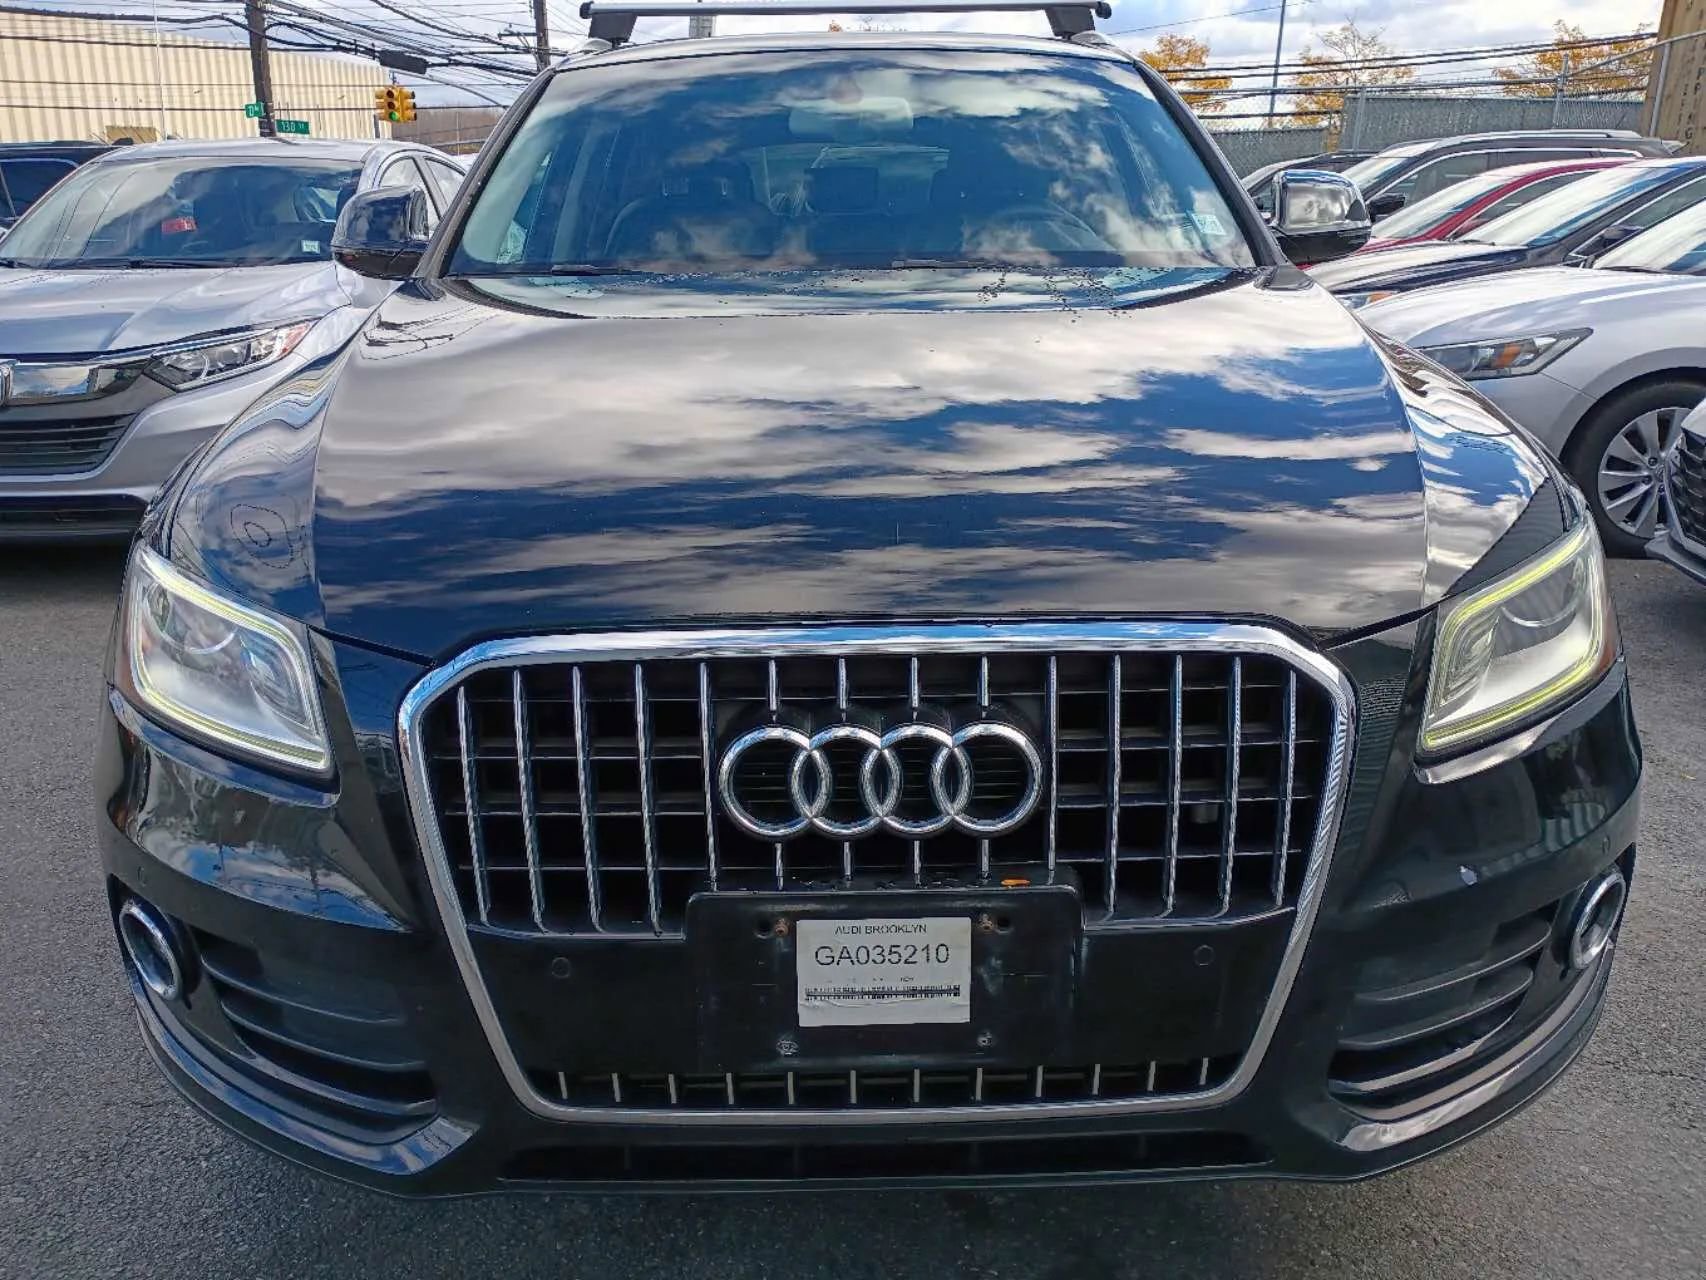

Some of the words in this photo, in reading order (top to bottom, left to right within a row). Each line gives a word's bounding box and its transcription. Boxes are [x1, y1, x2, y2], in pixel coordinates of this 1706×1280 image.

[834, 925, 862, 935] AUDI
[865, 923, 927, 934] BROOKLYN
[815, 943, 949, 966] GA035210
